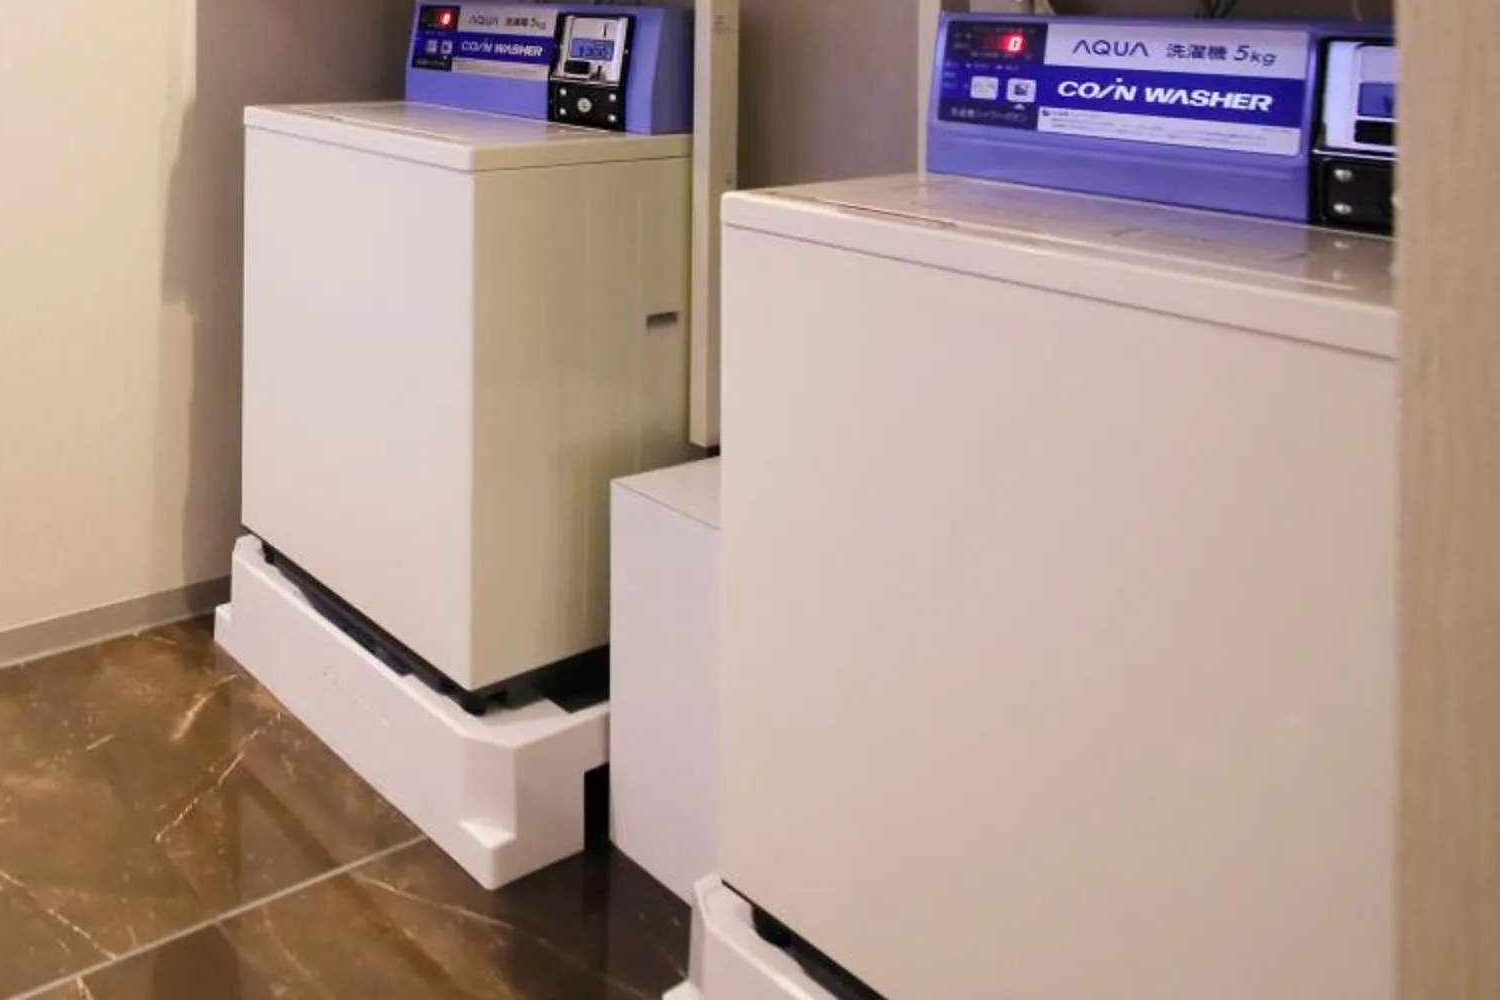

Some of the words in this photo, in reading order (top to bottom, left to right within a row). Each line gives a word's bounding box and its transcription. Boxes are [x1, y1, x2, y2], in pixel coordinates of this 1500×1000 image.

[495, 43, 543, 57] WASHER
[1072, 39, 1149, 57] AQUA
[1166, 42, 1228, 61] 洗濯機
[1233, 44, 1277, 67] 5kg
[1144, 87, 1273, 112] WASHER
